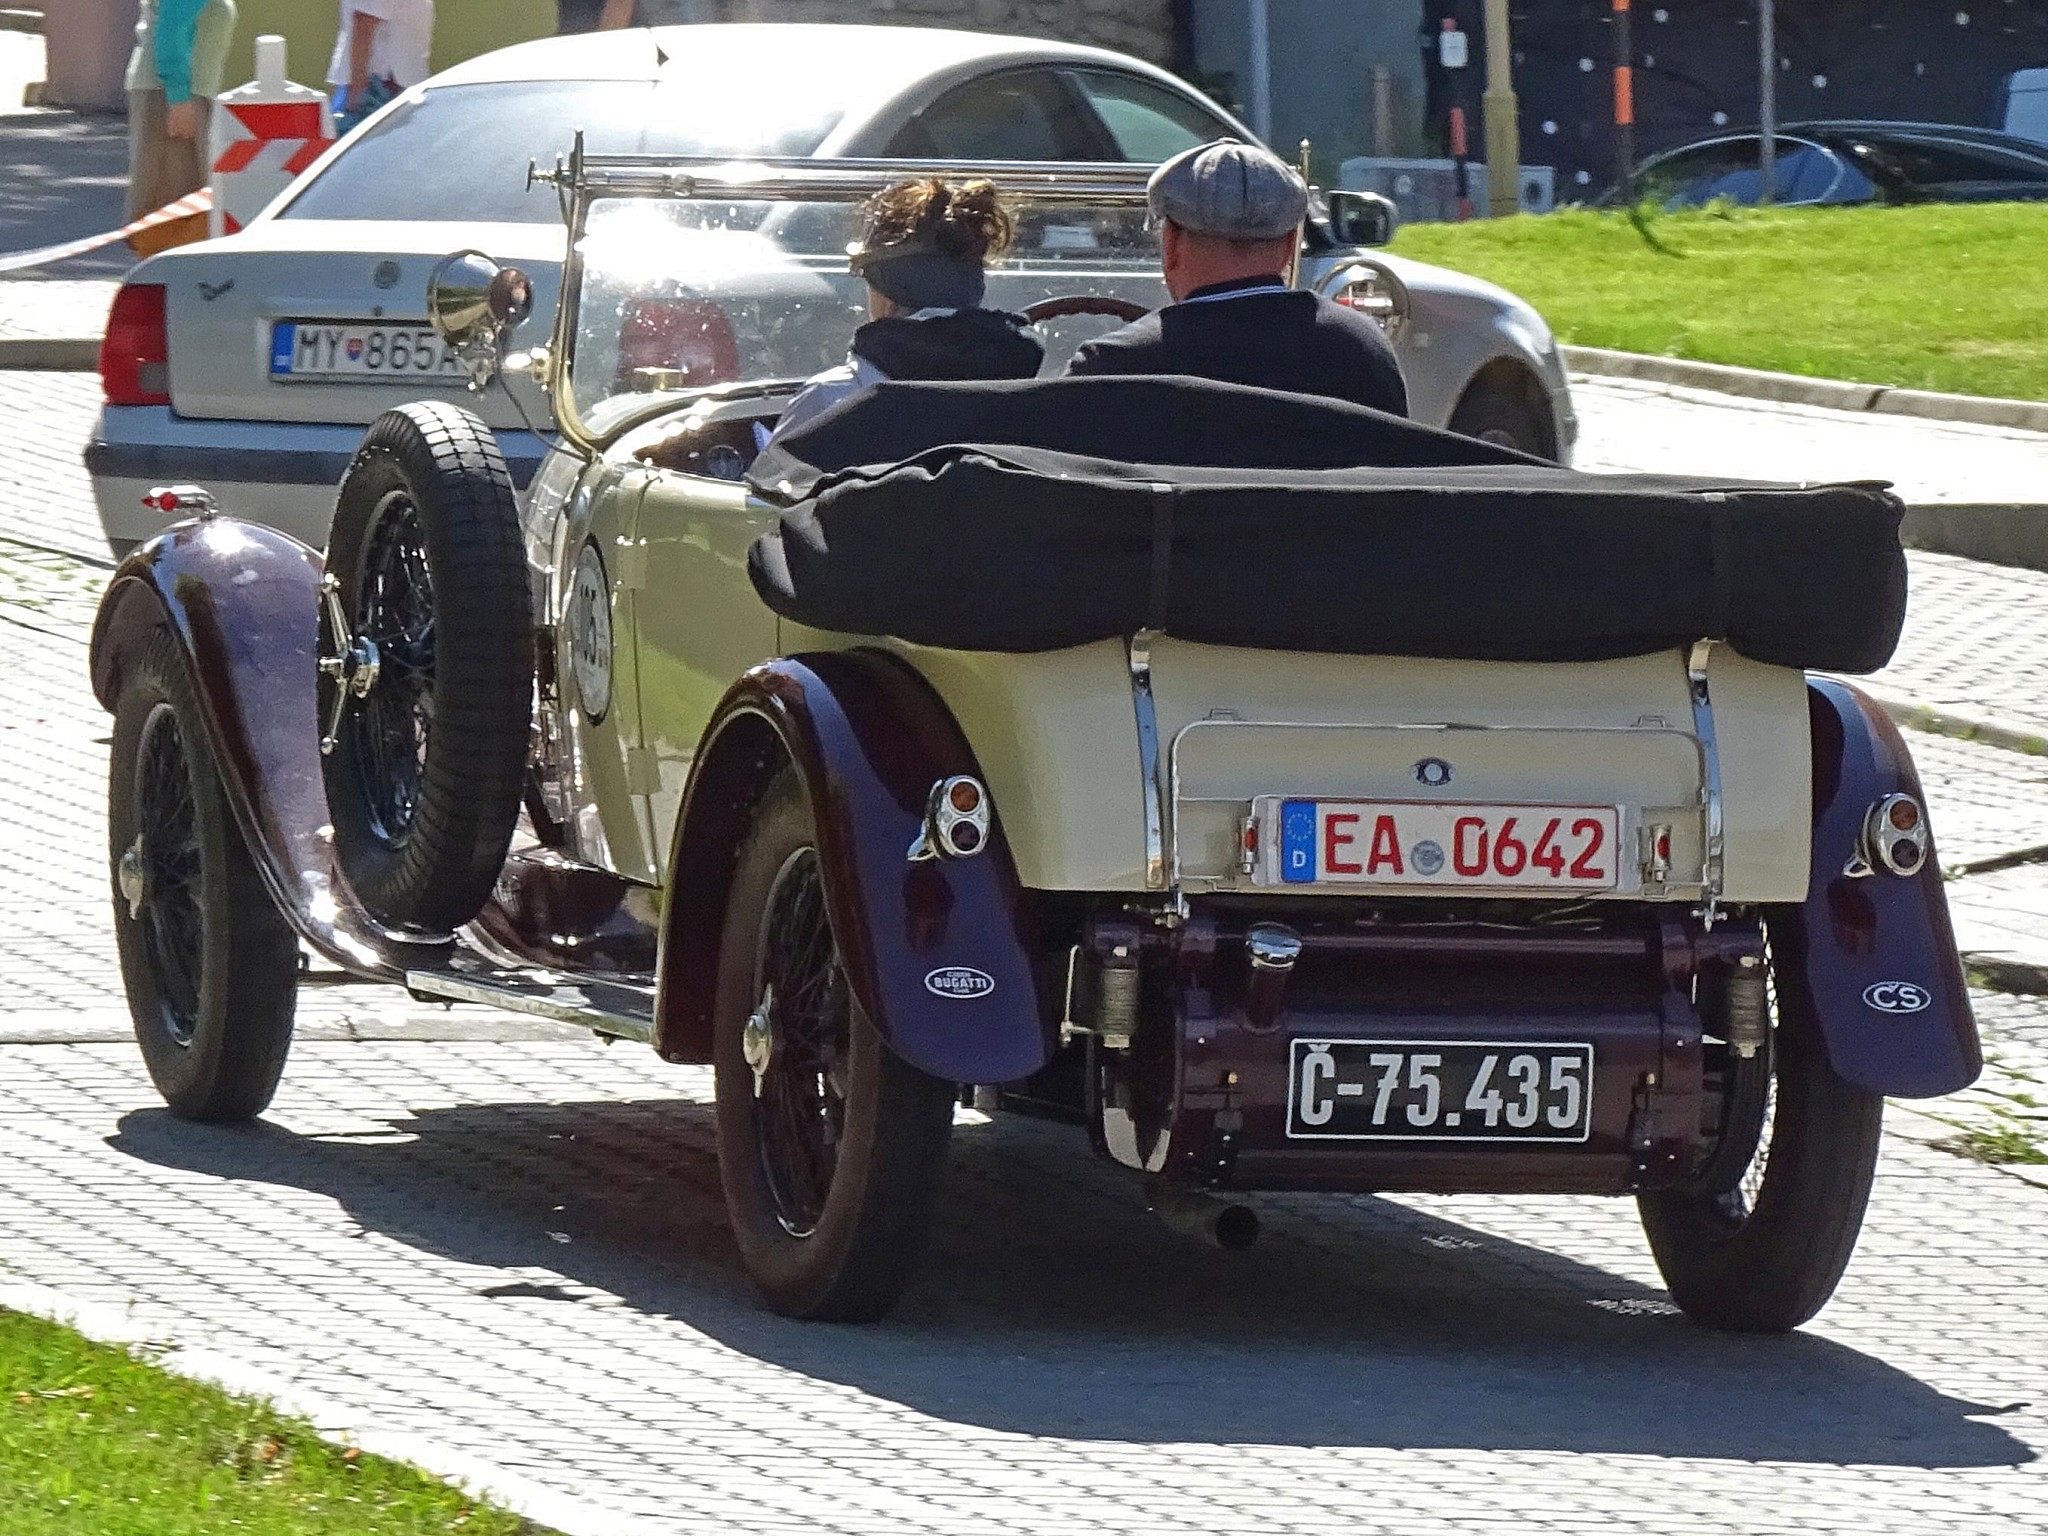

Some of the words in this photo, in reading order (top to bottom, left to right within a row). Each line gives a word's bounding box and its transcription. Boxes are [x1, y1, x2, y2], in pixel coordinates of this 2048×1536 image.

[297, 329, 343, 369] MY
[364, 331, 461, 372] 865A
[1292, 849, 1307, 868] D
[1325, 813, 1404, 875] EA
[1453, 816, 1606, 879] 0642
[933, 976, 987, 989] BUGATTI
